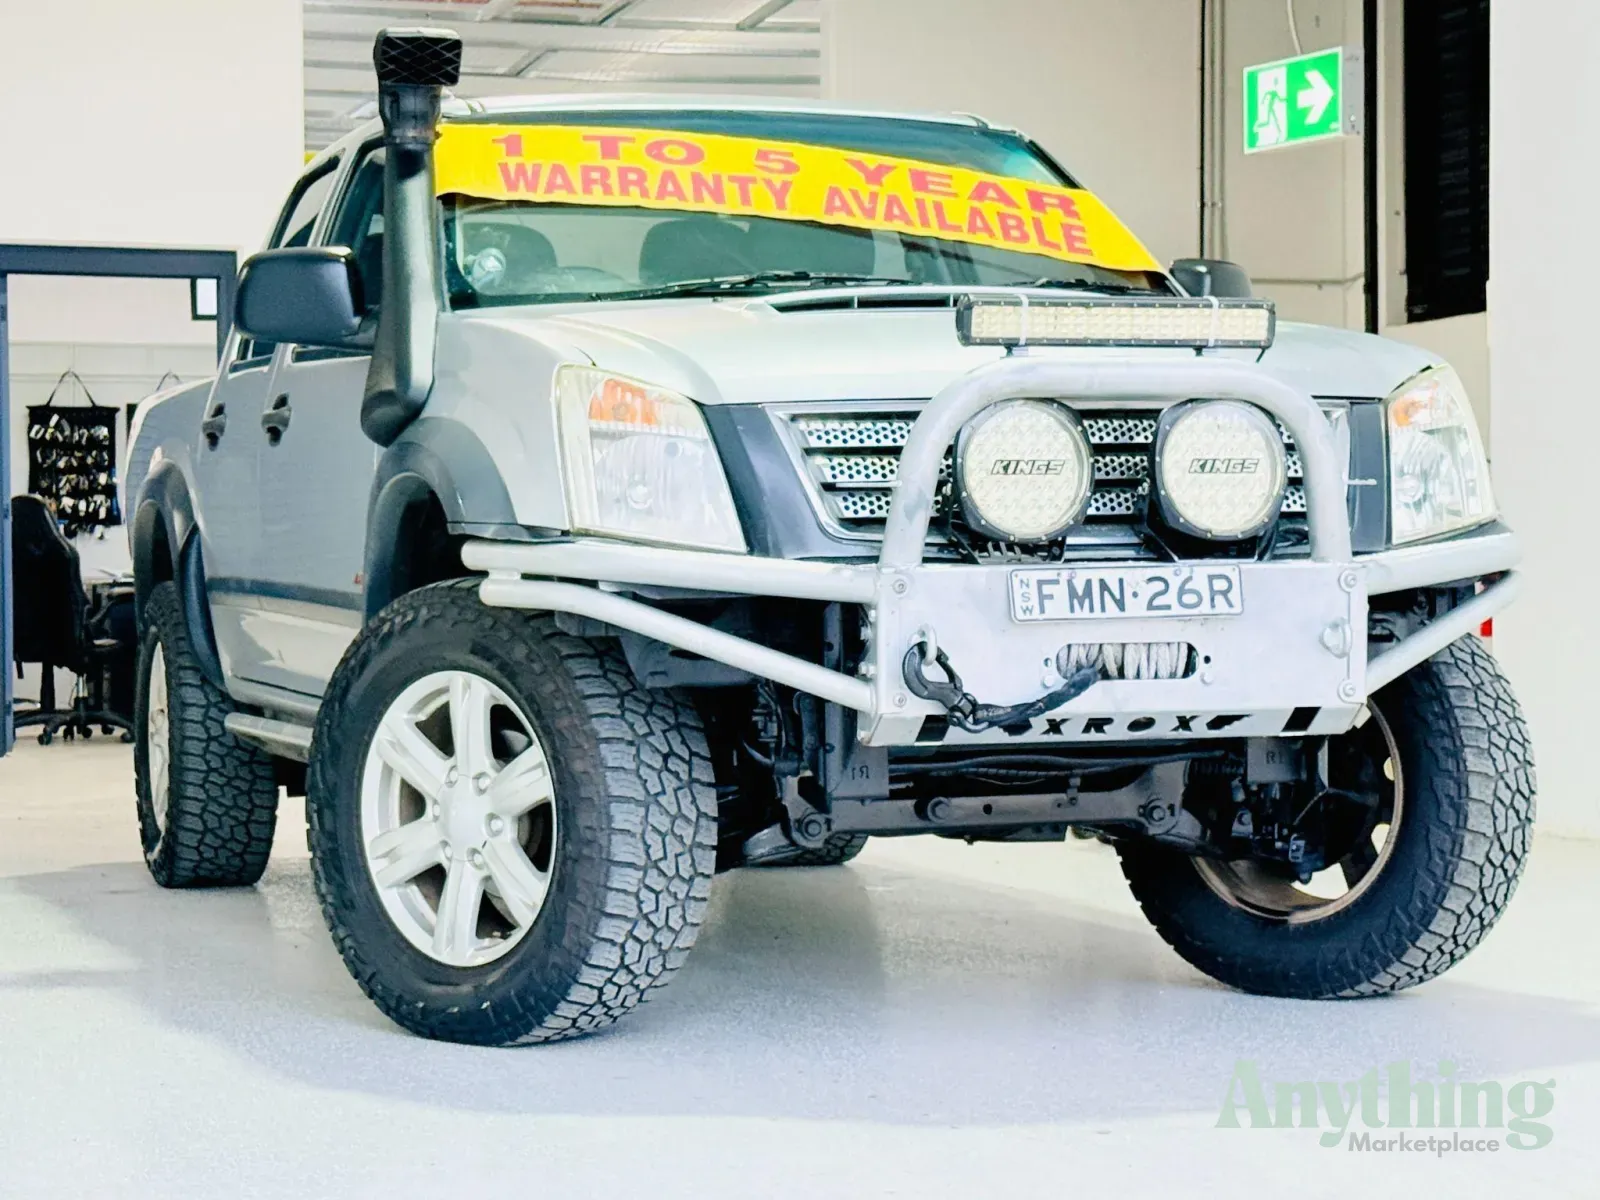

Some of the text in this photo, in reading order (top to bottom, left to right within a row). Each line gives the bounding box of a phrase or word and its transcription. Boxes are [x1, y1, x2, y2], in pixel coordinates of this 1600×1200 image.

[492, 134, 1082, 220] 1 TO 5 YEAR
[498, 162, 1093, 256] WARRANTY AVAILABLE
[991, 459, 1065, 475] KINGS
[1188, 458, 1259, 474] KINGS
[1039, 715, 1203, 736] XROX
